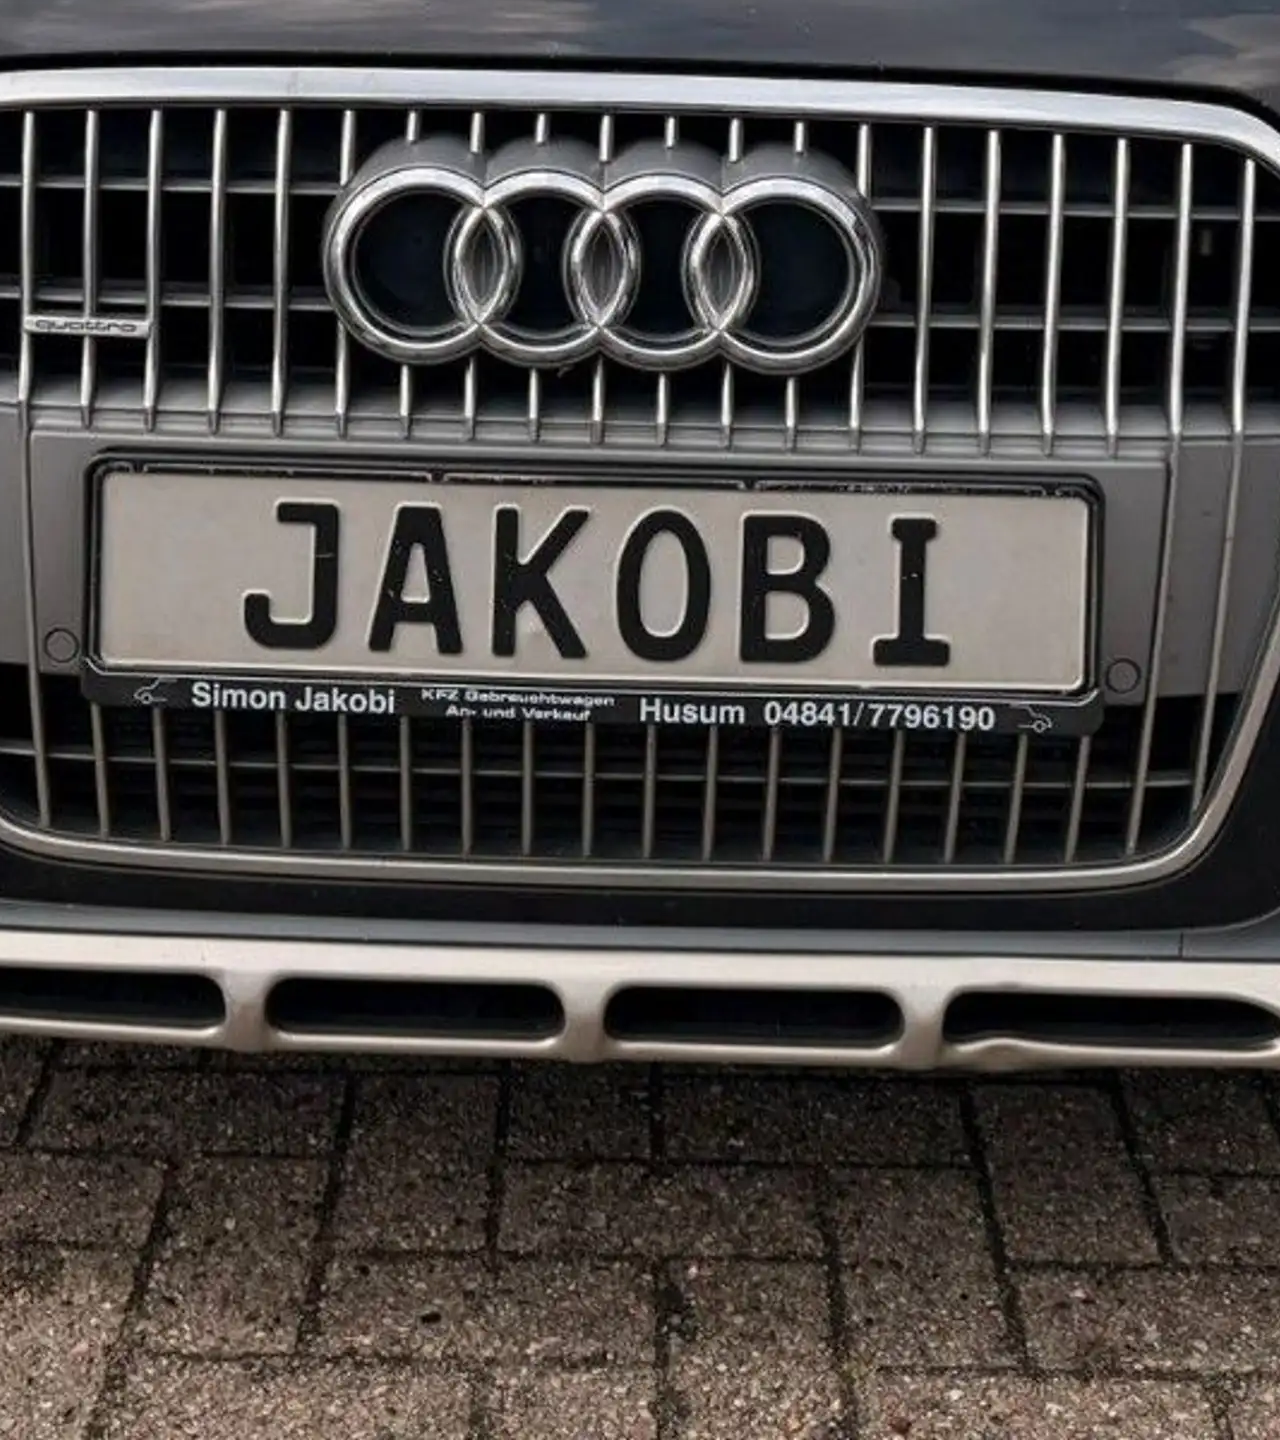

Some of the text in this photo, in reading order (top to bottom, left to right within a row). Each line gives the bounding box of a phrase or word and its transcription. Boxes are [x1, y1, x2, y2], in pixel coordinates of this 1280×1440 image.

[34, 318, 138, 334] quattro
[241, 500, 952, 666] JAKOBI
[191, 682, 395, 714] Simon Jakobi
[420, 687, 616, 707] KFZ Gebrauchtwagen
[445, 704, 592, 722] An- und Verkauf
[639, 696, 746, 726] Husum
